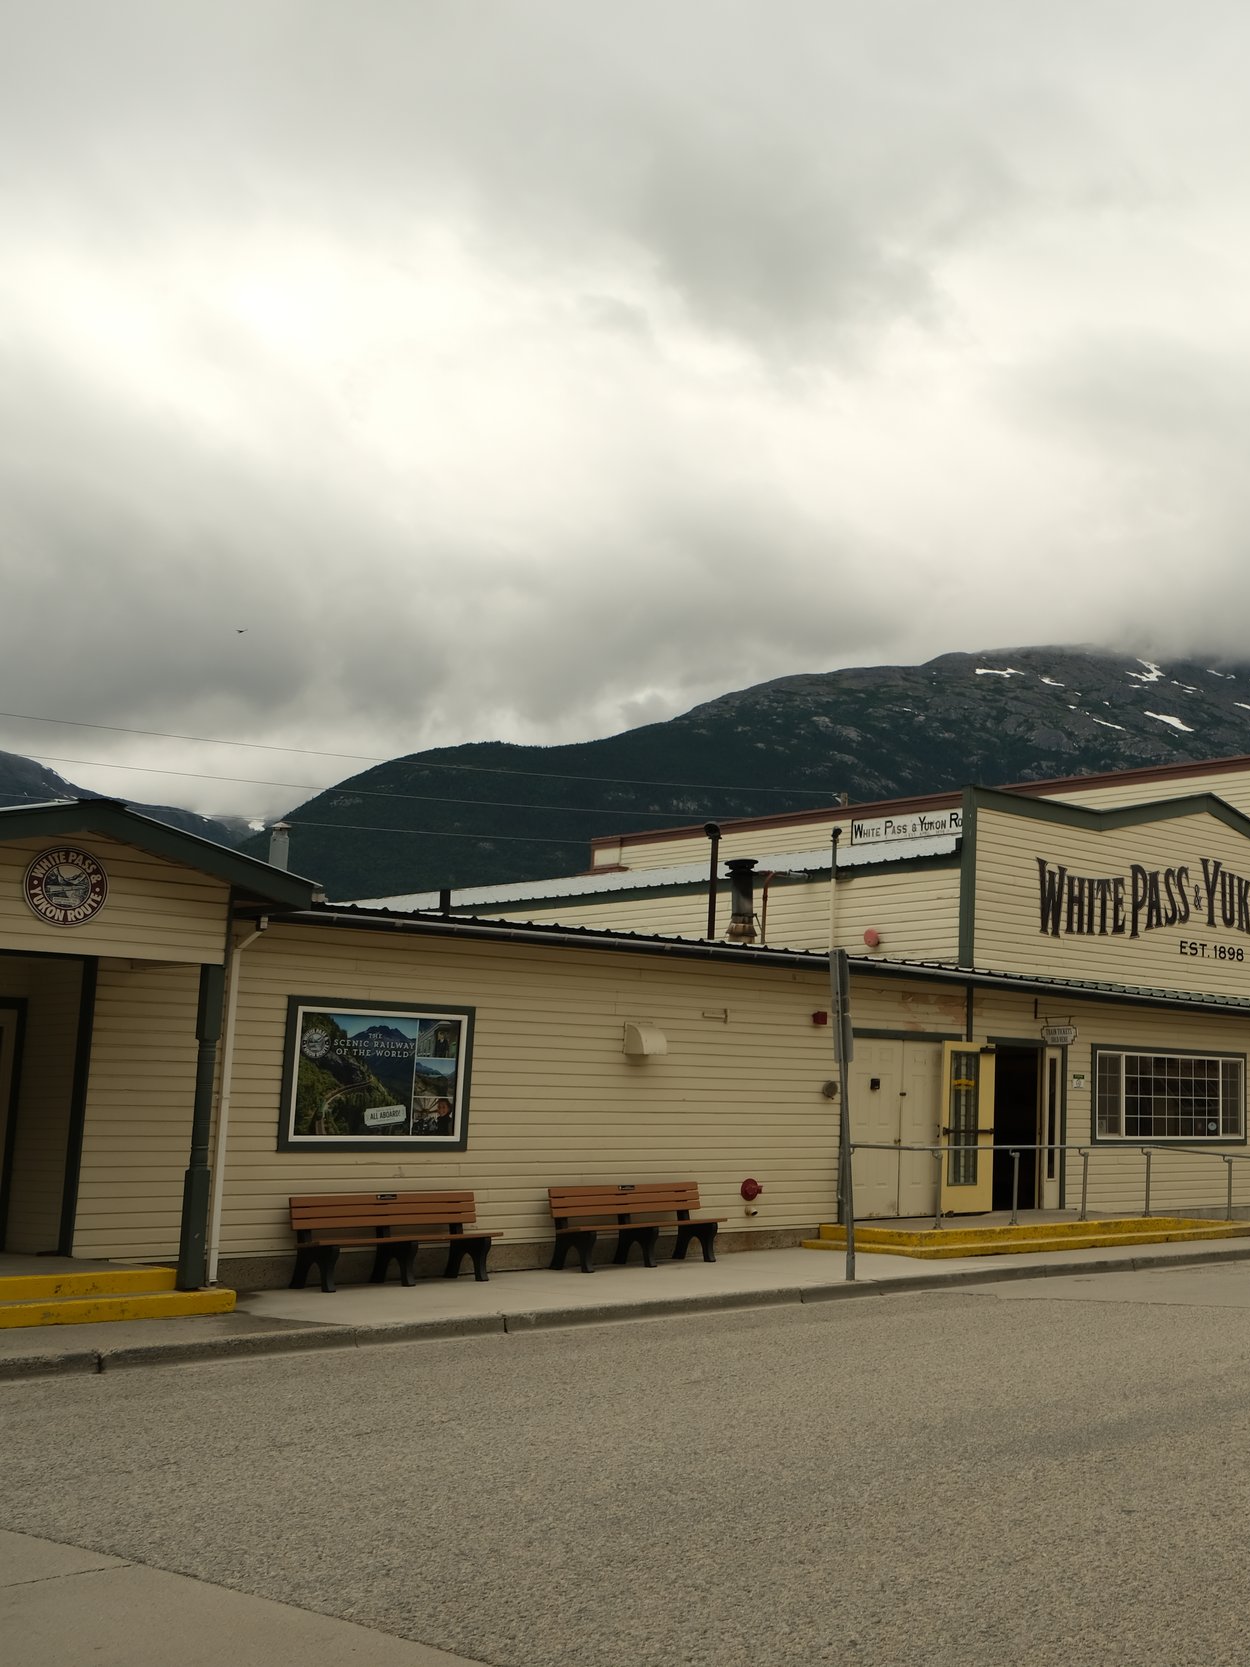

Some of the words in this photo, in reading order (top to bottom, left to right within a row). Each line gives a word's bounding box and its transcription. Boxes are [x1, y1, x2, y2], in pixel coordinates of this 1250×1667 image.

[854, 823, 881, 839] WHITE
[884, 820, 907, 836] PASS
[911, 824, 917, 833] &
[918, 814, 946, 832] YUKON
[31, 851, 66, 878] WHITE
[67, 851, 98, 873] PASS
[90, 874, 102, 884] &
[30, 886, 65, 921] YUKON
[66, 892, 102, 921] ROUTE
[1036, 857, 1127, 938] WHITE
[1129, 864, 1191, 939] PASS
[1193, 884, 1203, 911] &
[1179, 940, 1210, 958] EST.
[1213, 944, 1245, 962] 1898
[333, 1039, 369, 1048] SCENIC
[373, 1040, 415, 1050] RAILWAY
[335, 1048, 348, 1056] OF
[352, 1048, 372, 1057] THE
[376, 1049, 409, 1058] WORLD
[370, 1112, 379, 1120] ALL
